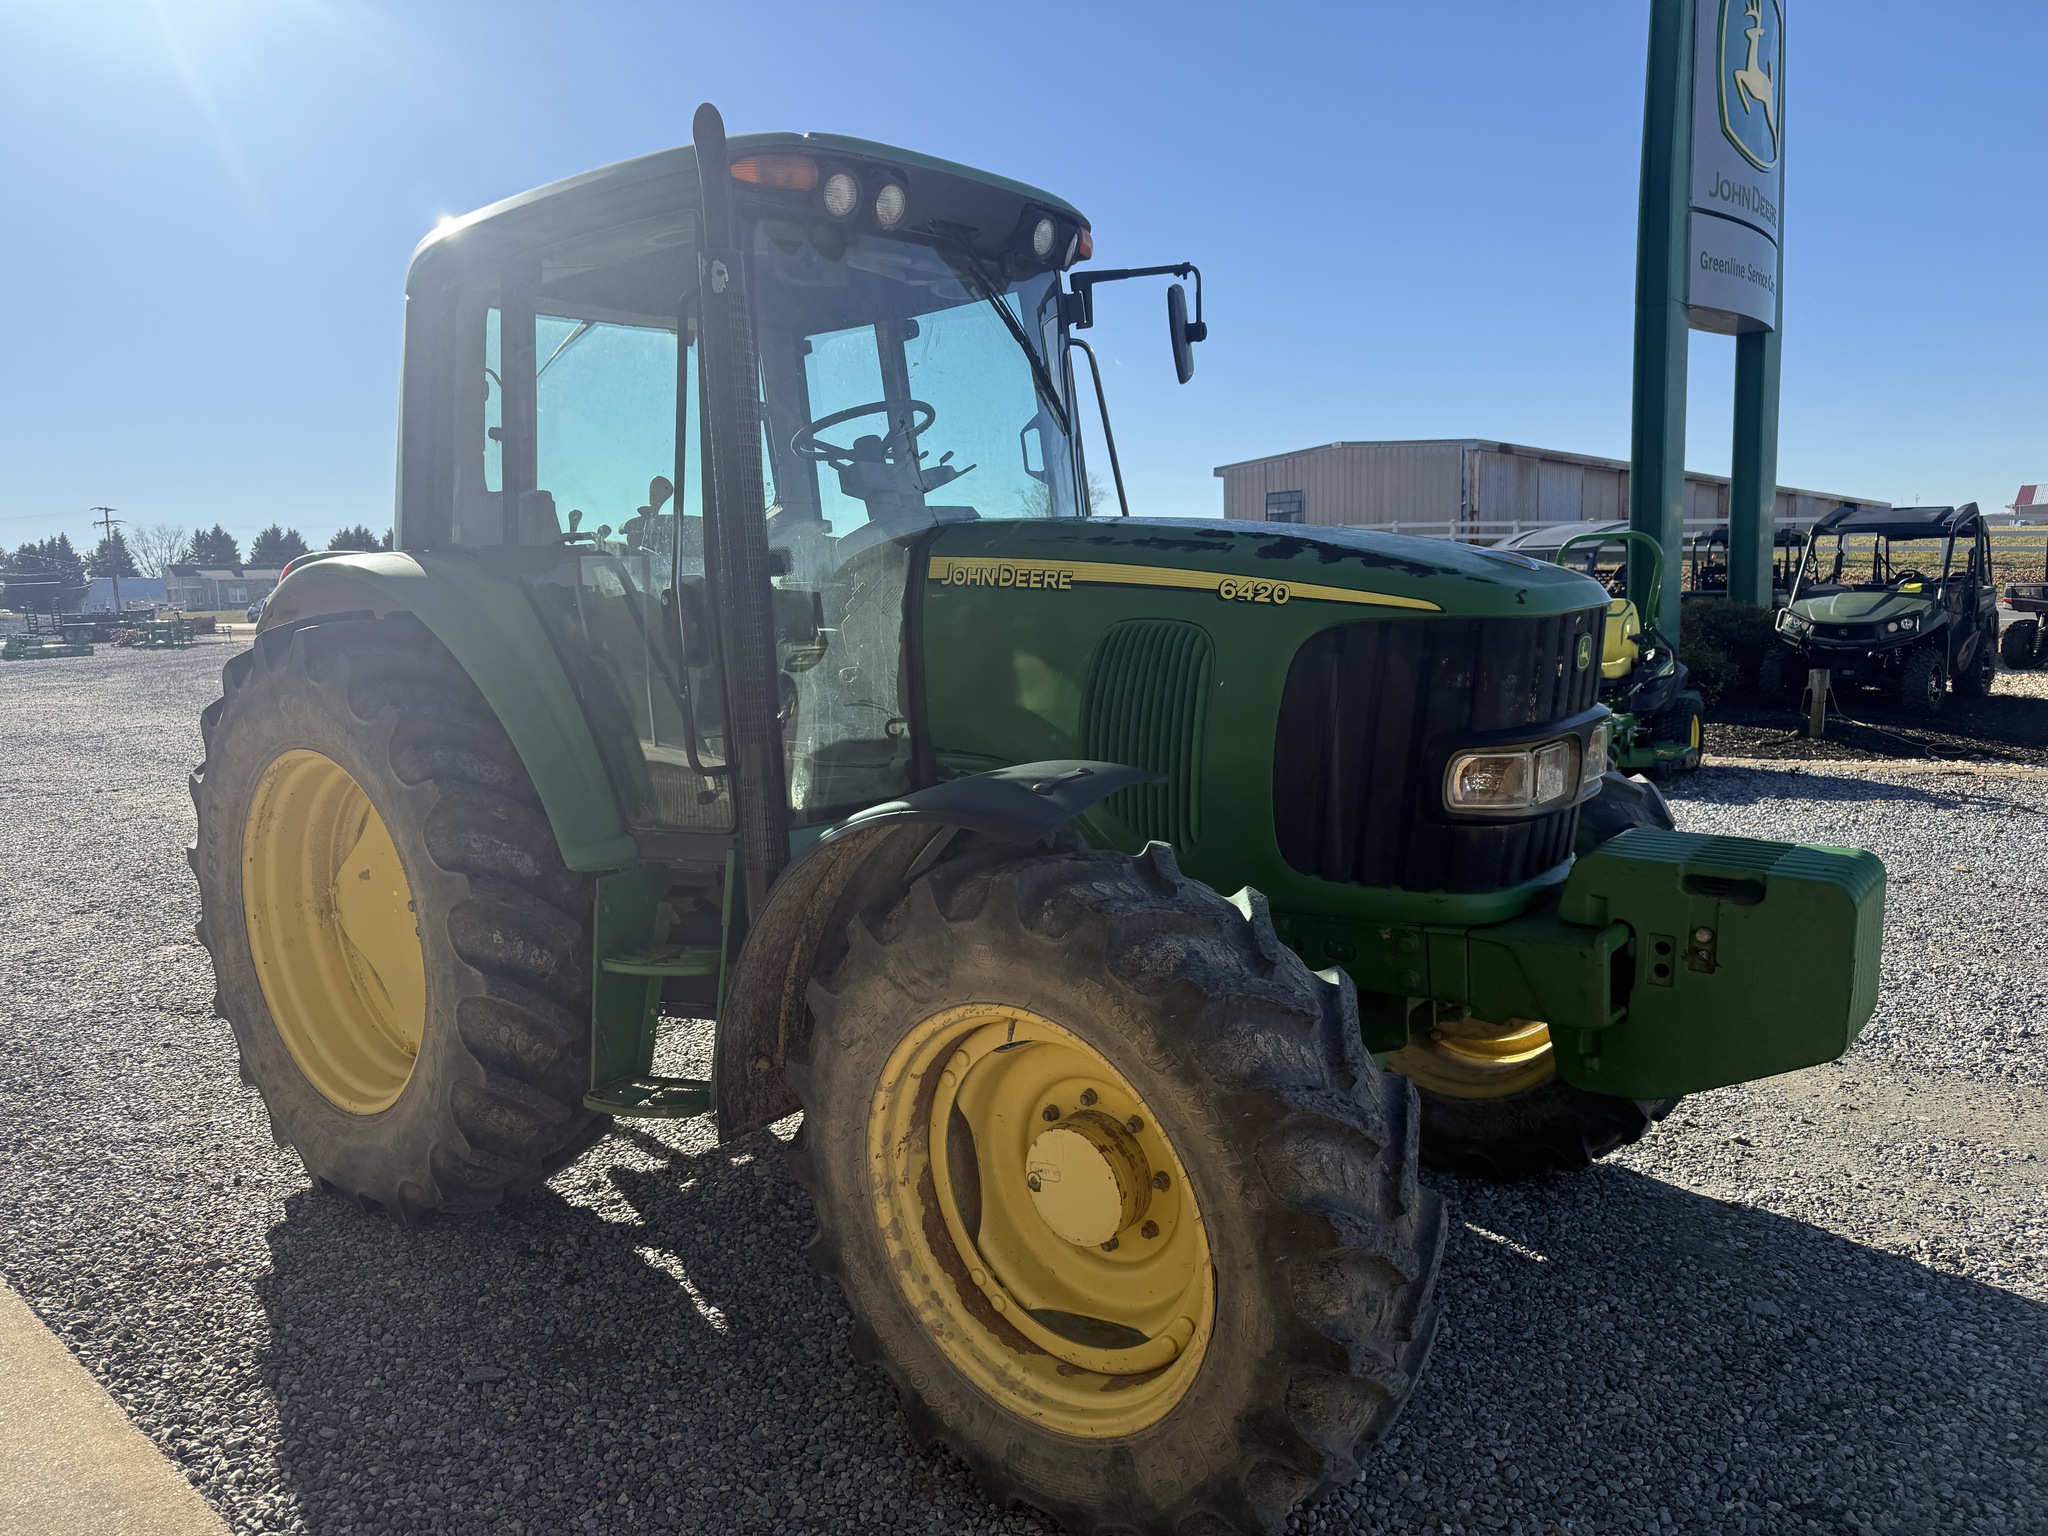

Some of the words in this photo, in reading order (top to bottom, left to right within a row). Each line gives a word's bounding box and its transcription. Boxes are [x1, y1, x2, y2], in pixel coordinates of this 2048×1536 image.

[1709, 172, 1750, 208] JOHN
[1752, 186, 1777, 229] DEERE
[1700, 250, 1745, 279] Greenline
[1747, 263, 1767, 289] Service
[942, 562, 997, 587] JOHN
[998, 564, 1074, 591] DEERE
[1219, 578, 1292, 605] 6420
